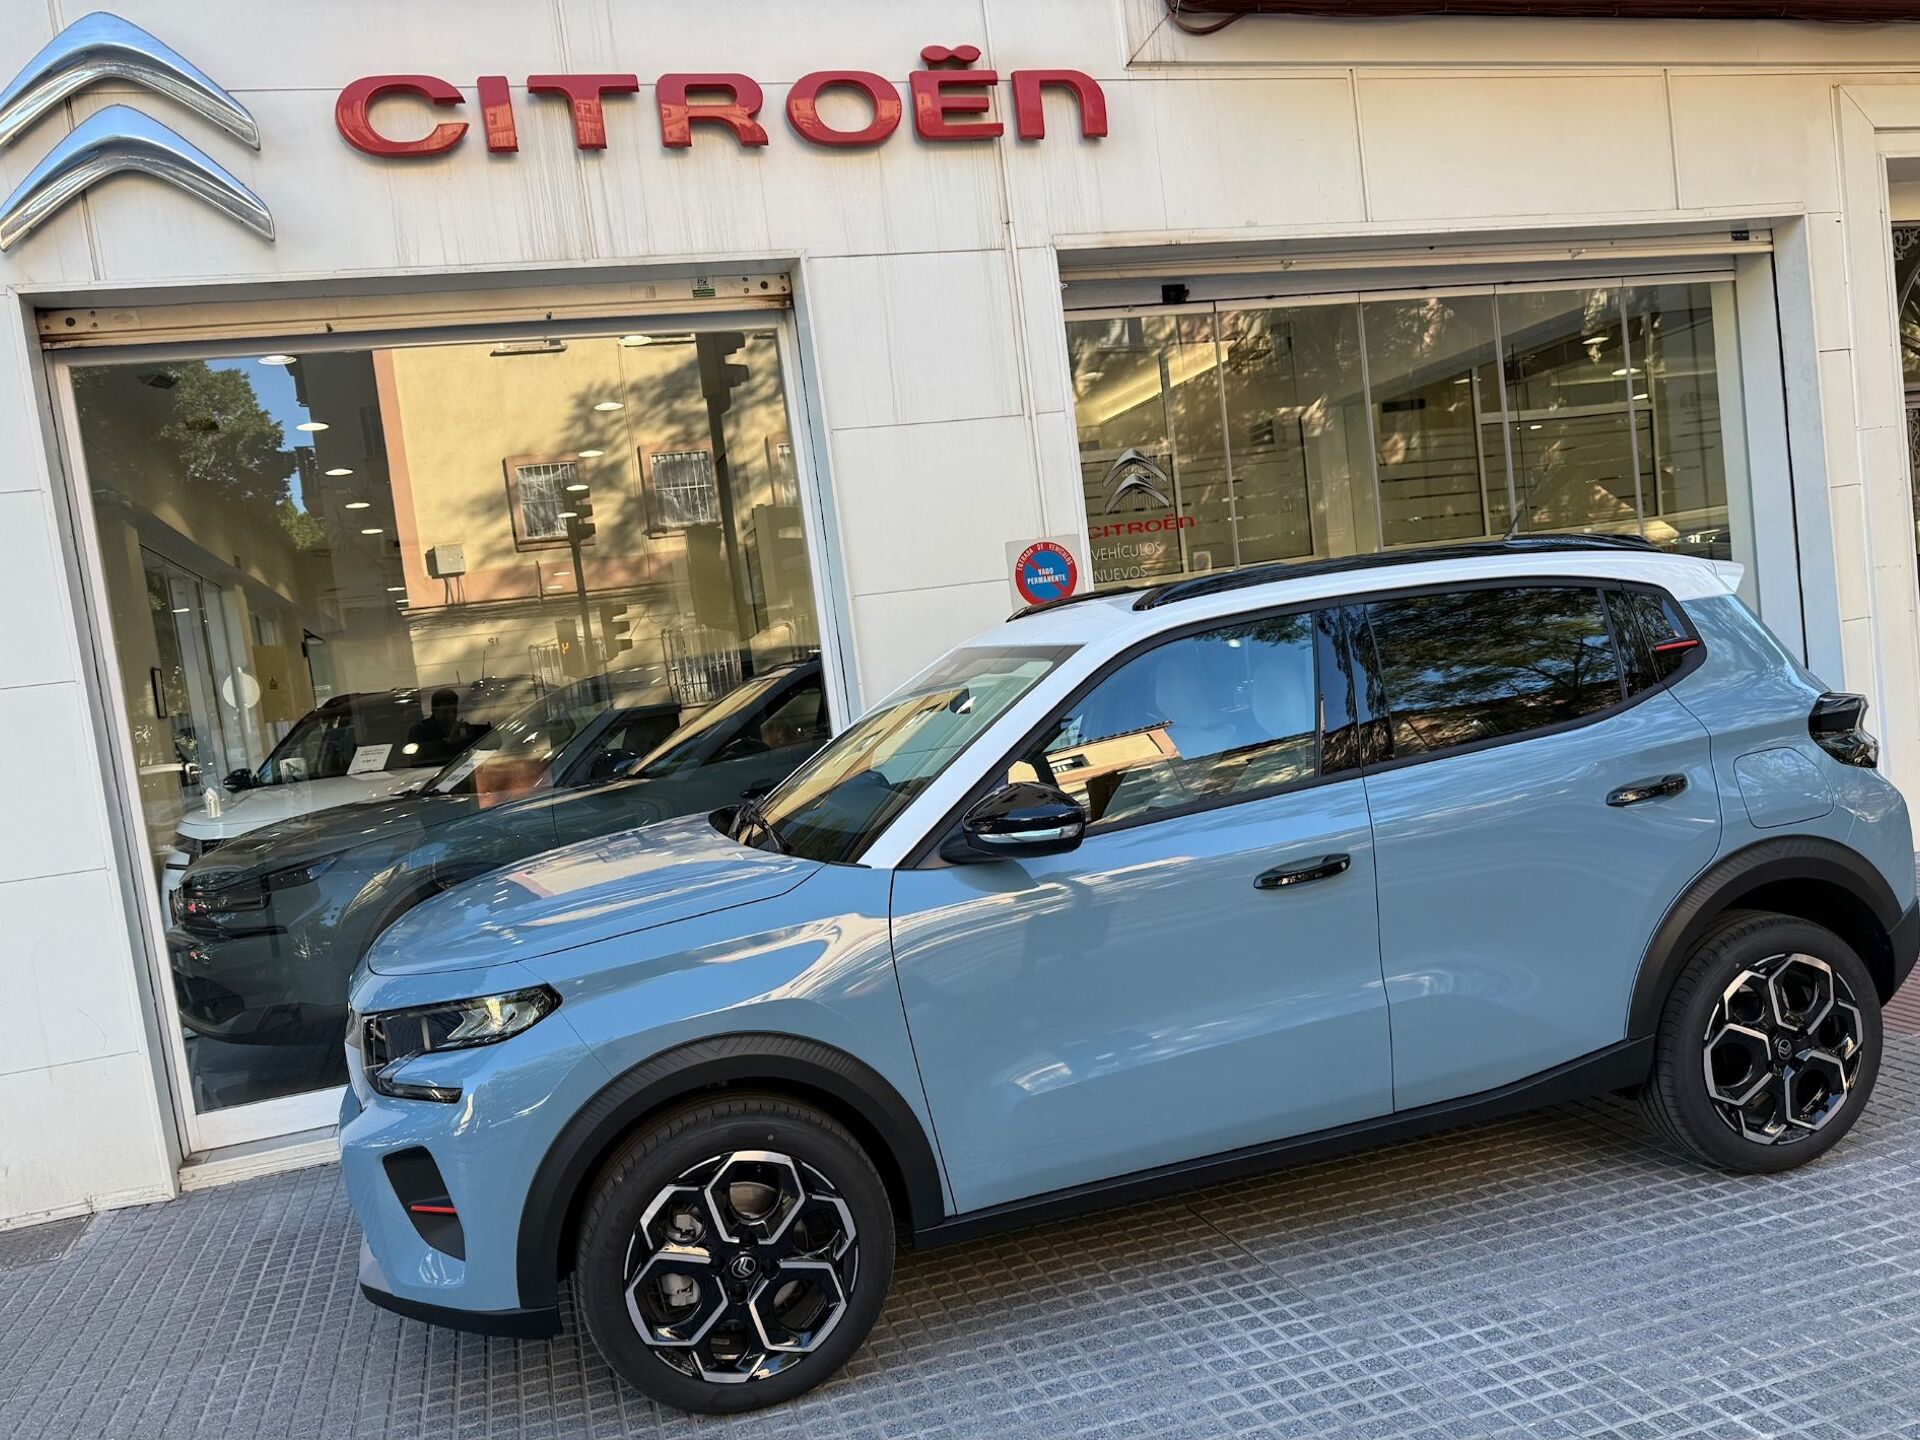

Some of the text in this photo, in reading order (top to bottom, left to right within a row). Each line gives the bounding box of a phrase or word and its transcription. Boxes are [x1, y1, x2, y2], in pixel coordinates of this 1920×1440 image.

[1017, 548, 1034, 571] ENTRADA
[1036, 543, 1045, 551] DE
[1091, 541, 1162, 561] VEHÍCULOS
[1027, 573, 1067, 585] PERMANENTE
[1037, 567, 1054, 576] VADO
[1094, 565, 1148, 582] NUEVOS
